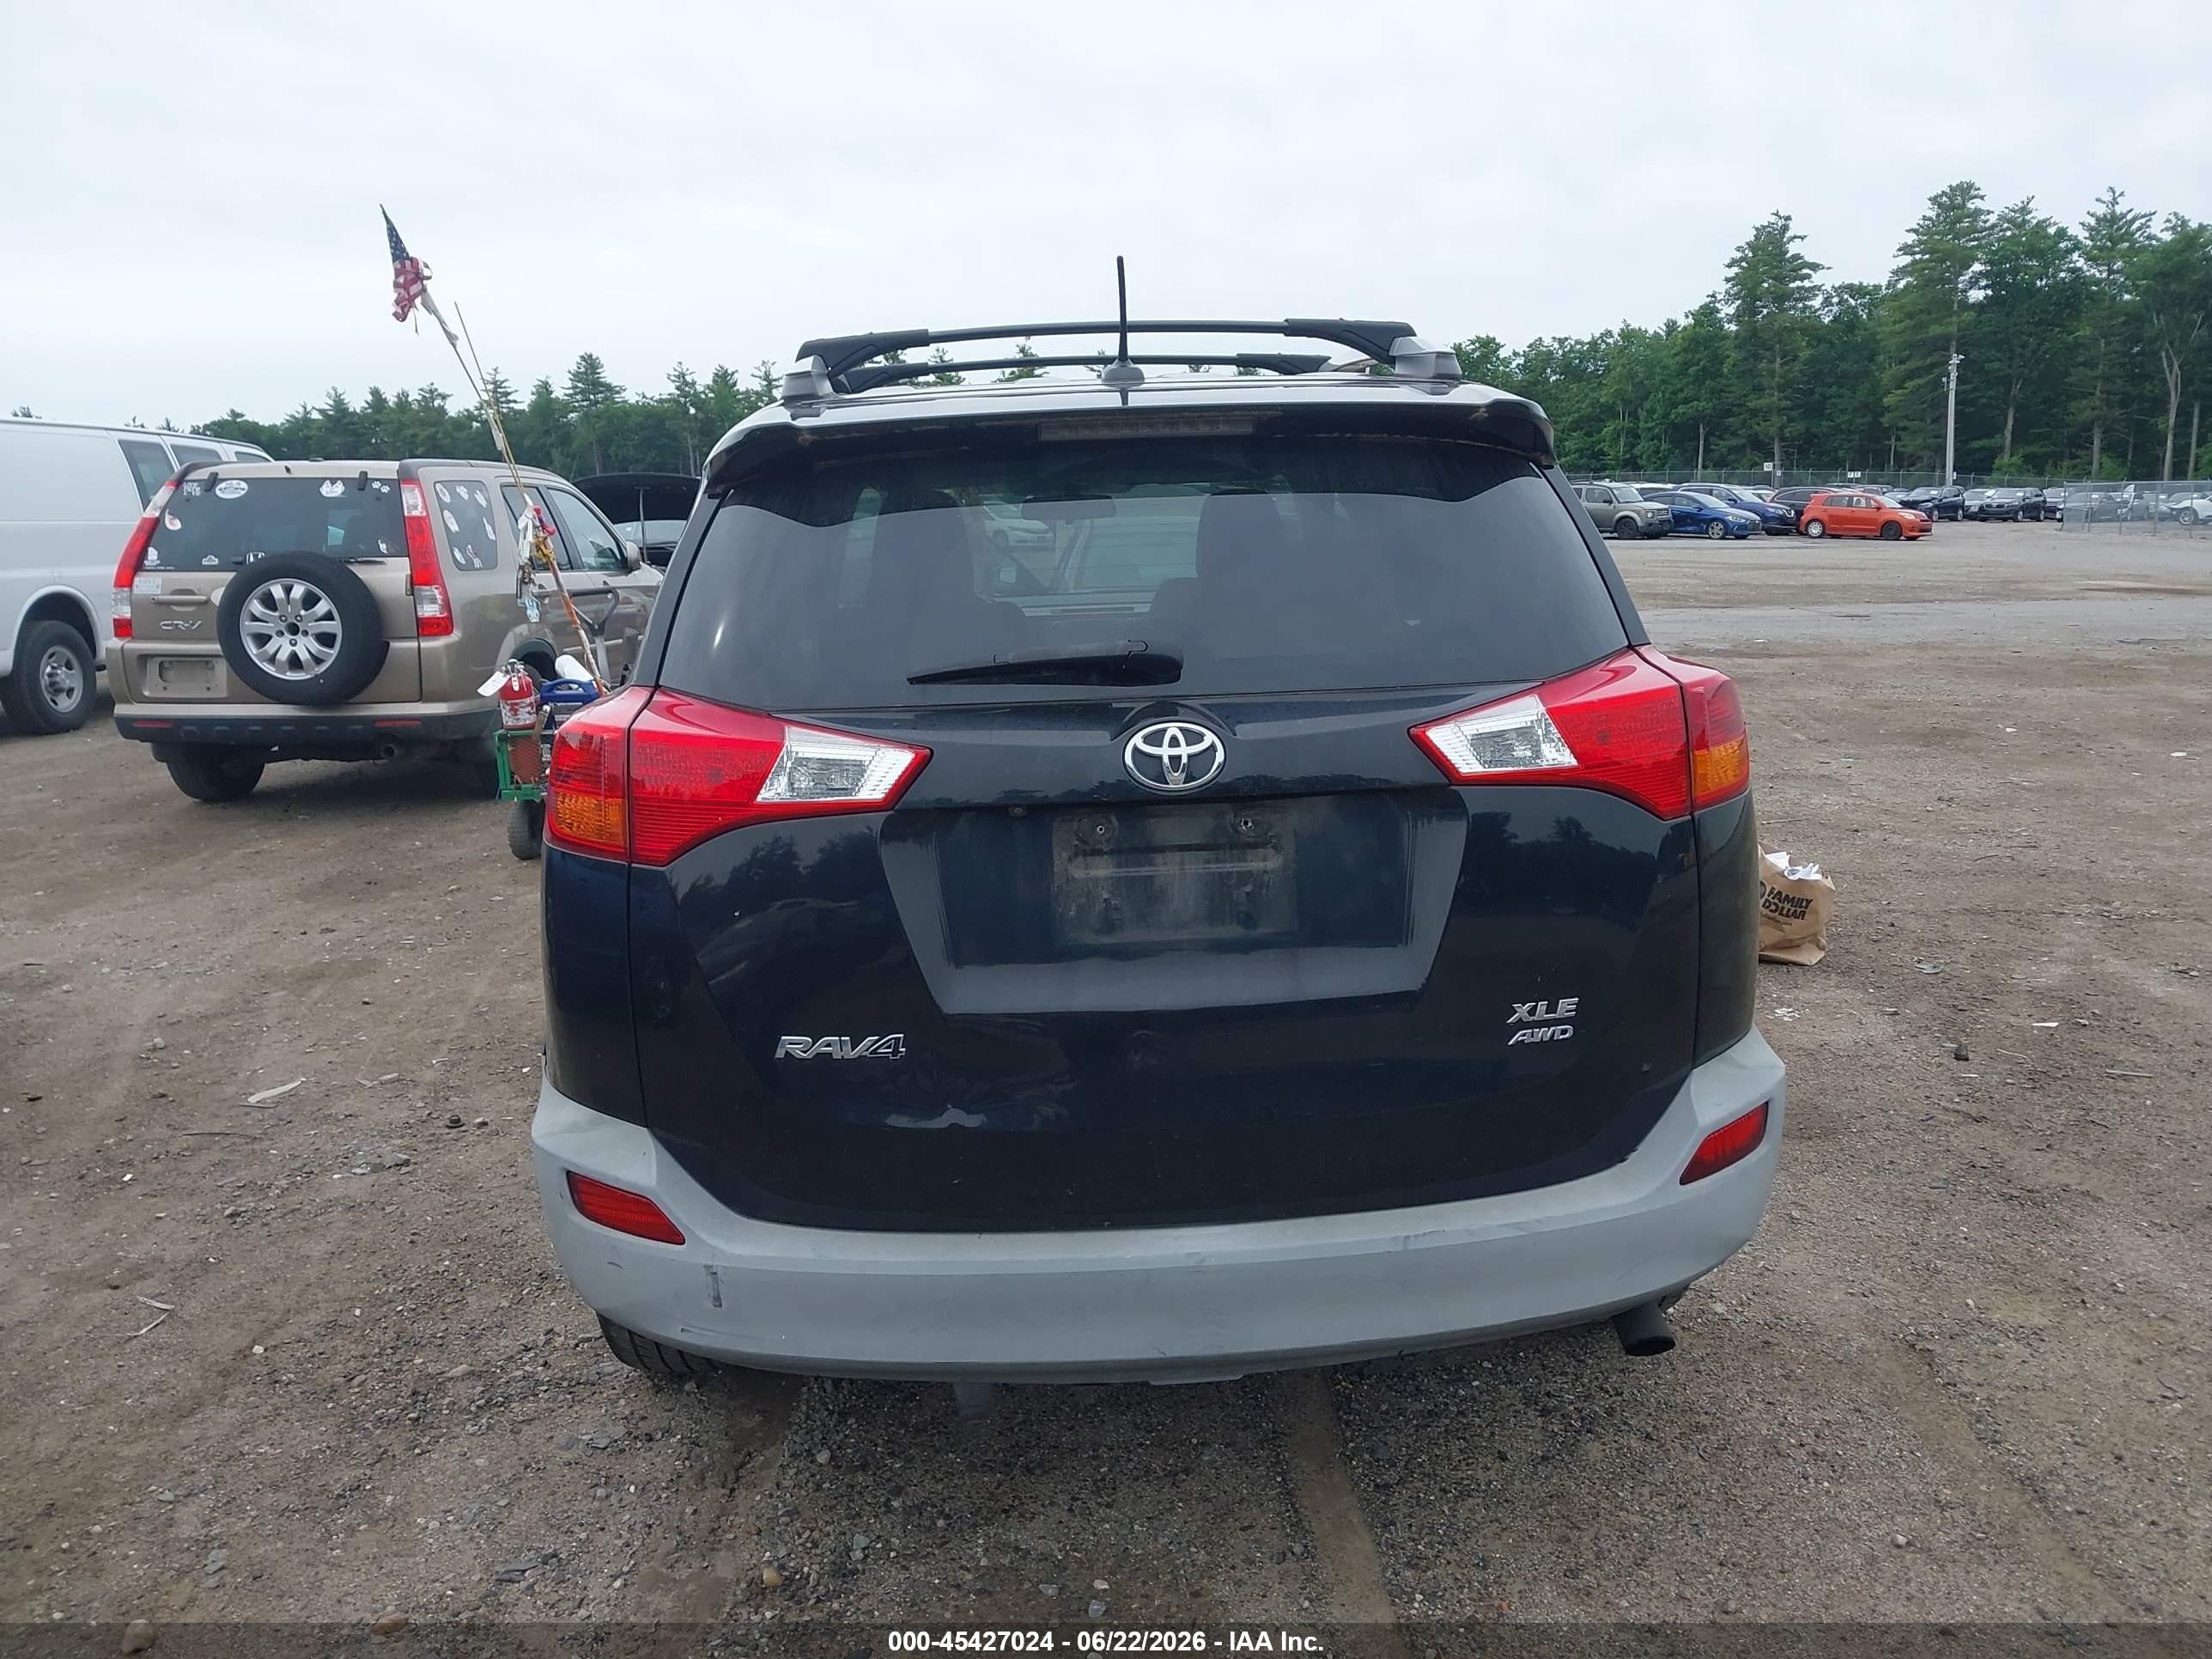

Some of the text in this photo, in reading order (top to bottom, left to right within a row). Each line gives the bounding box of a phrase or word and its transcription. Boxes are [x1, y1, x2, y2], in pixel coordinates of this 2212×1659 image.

[160, 620, 202, 630] CR-V
[1767, 886, 1814, 909] FAMILY
[1762, 898, 1807, 921] DOLLAR
[1506, 998, 1579, 1022] XLE
[775, 1034, 906, 1059] RAV4
[1508, 1025, 1574, 1045] AWD
